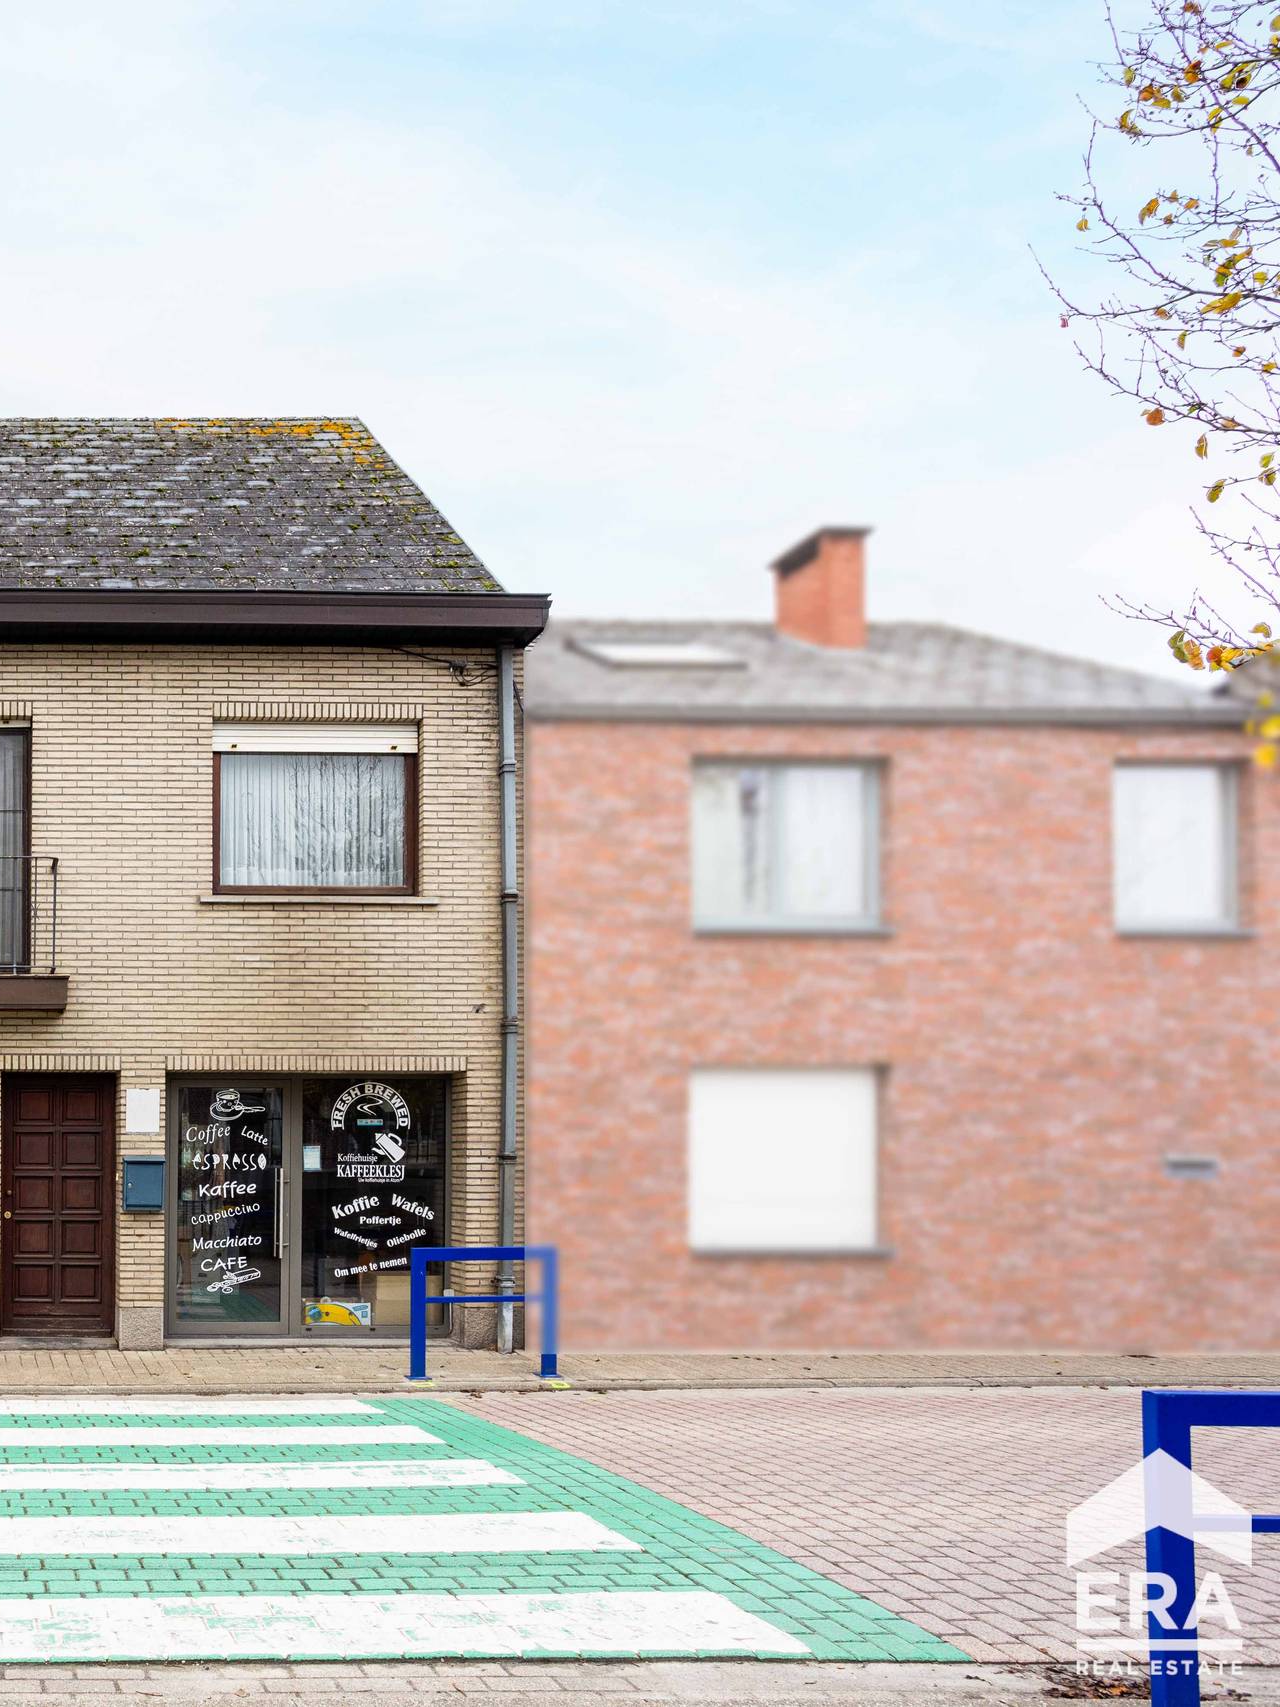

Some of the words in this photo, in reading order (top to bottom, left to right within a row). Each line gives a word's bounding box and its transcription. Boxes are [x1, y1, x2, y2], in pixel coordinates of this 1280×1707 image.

[331, 1087, 361, 1128] FRESH
[364, 1084, 408, 1127] BREWED
[186, 1123, 231, 1144] Coffee
[240, 1125, 269, 1146] Latte
[337, 1153, 378, 1163] Koffiehuisje
[336, 1164, 406, 1182] KAFFEEKLESJ
[198, 1180, 257, 1199] Kaffee
[191, 1203, 261, 1226] cappuccino
[331, 1194, 380, 1220] Koffie
[391, 1193, 435, 1221] Wafels
[359, 1215, 402, 1227] Poffertje
[192, 1234, 262, 1252] Macchiato
[386, 1227, 427, 1248] Oliebolle
[200, 1256, 248, 1272] CAFE
[334, 1267, 348, 1278] Om
[350, 1264, 368, 1274] mee
[369, 1262, 379, 1272] te
[379, 1256, 408, 1271] nemen
